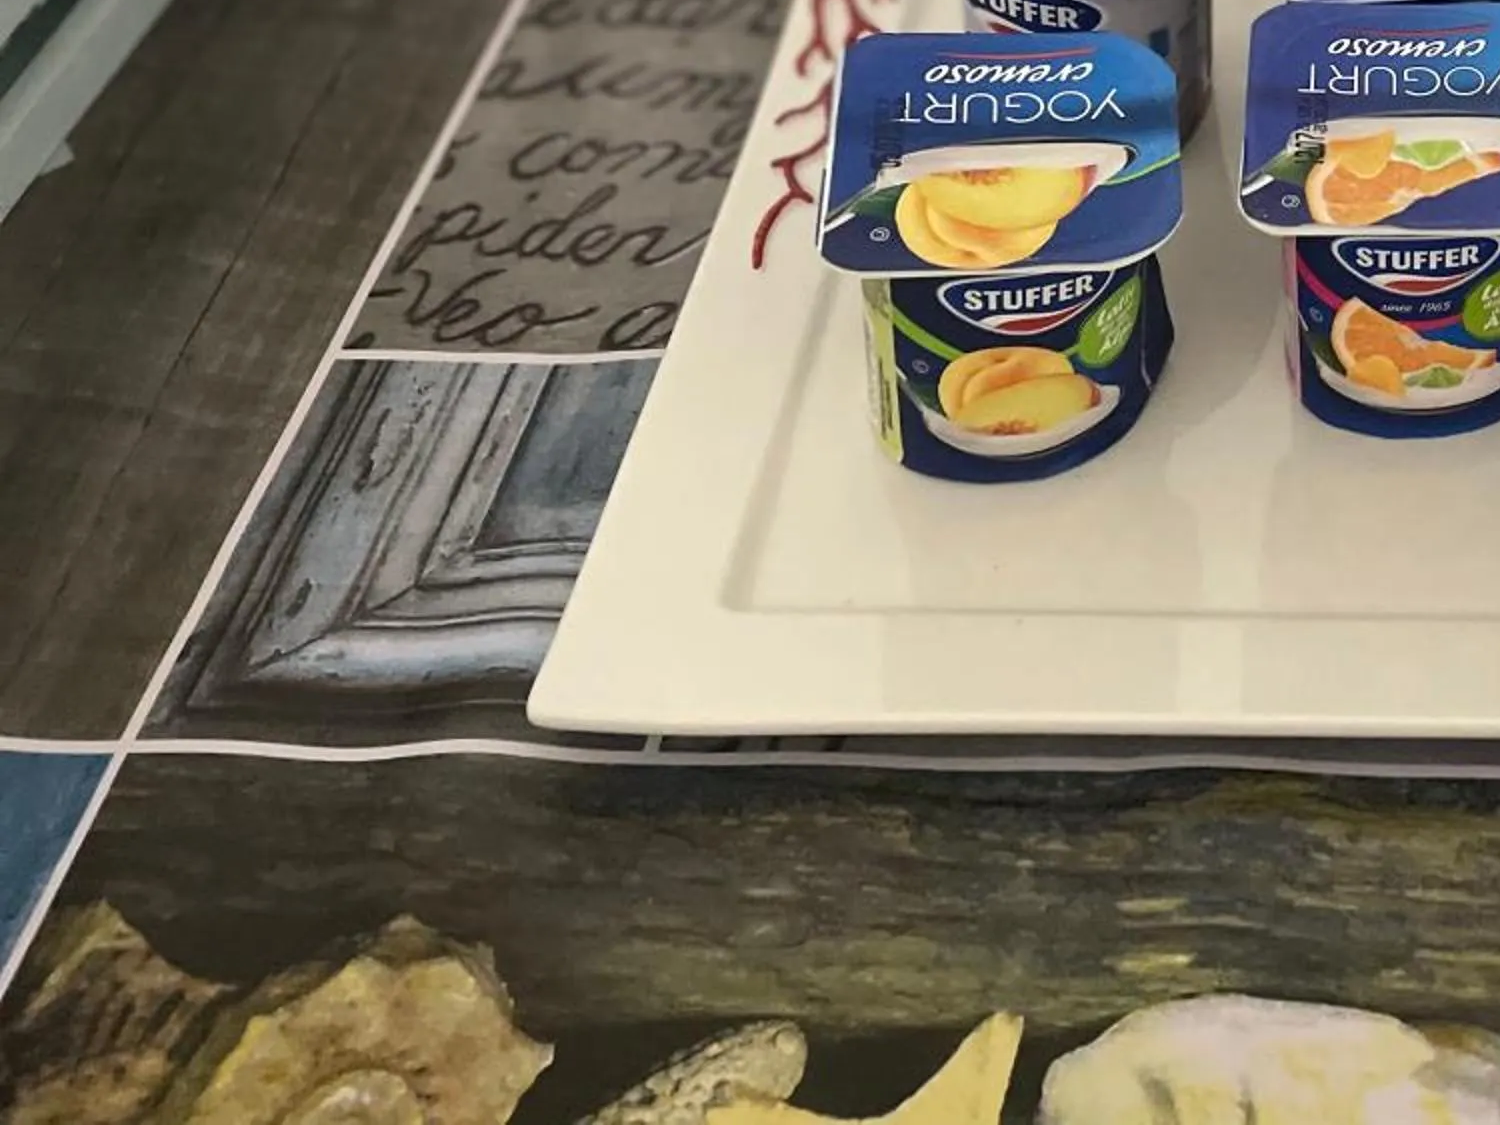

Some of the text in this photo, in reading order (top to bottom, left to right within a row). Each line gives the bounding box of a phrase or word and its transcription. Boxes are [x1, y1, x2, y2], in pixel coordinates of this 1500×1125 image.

[1328, 38, 1487, 57] cremoso
[924, 62, 1094, 83] cremoso
[891, 88, 1126, 124] YOGURT
[1356, 244, 1480, 270] STUFFER
[964, 275, 1094, 311] STUFFER
